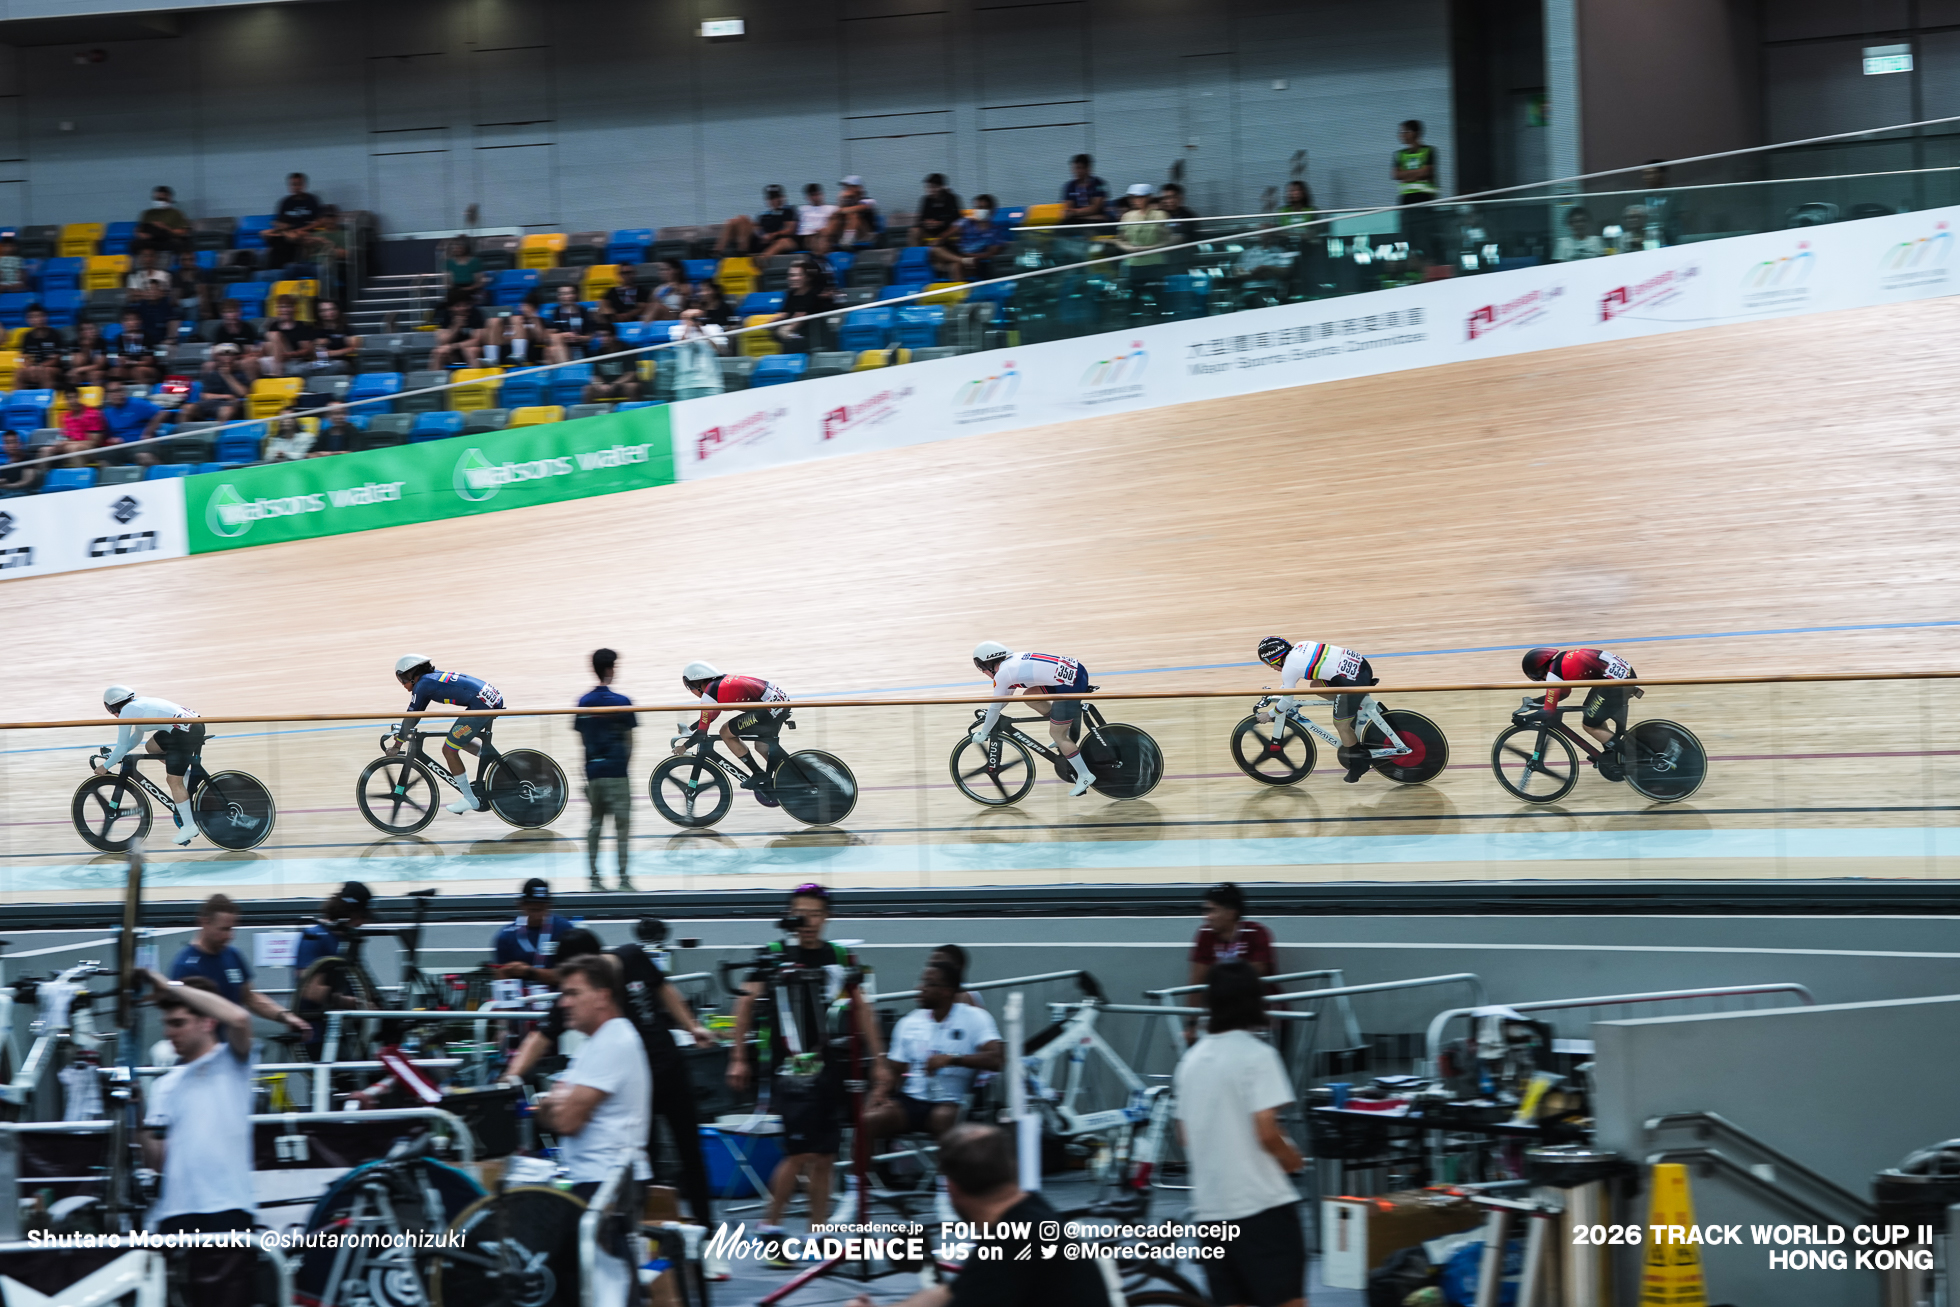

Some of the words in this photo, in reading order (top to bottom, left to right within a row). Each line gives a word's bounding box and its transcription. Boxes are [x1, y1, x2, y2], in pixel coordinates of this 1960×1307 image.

[1057, 664, 1075, 681] 358
[1340, 658, 1358, 676] 393
[1608, 661, 1626, 679] 333
[1333, 694, 1342, 714] JAPA
[1012, 731, 1046, 754] hope
[989, 741, 998, 769] LOTUS
[427, 761, 459, 788] KOG
[718, 759, 749, 783] KOG
[140, 778, 176, 812] KOGA
